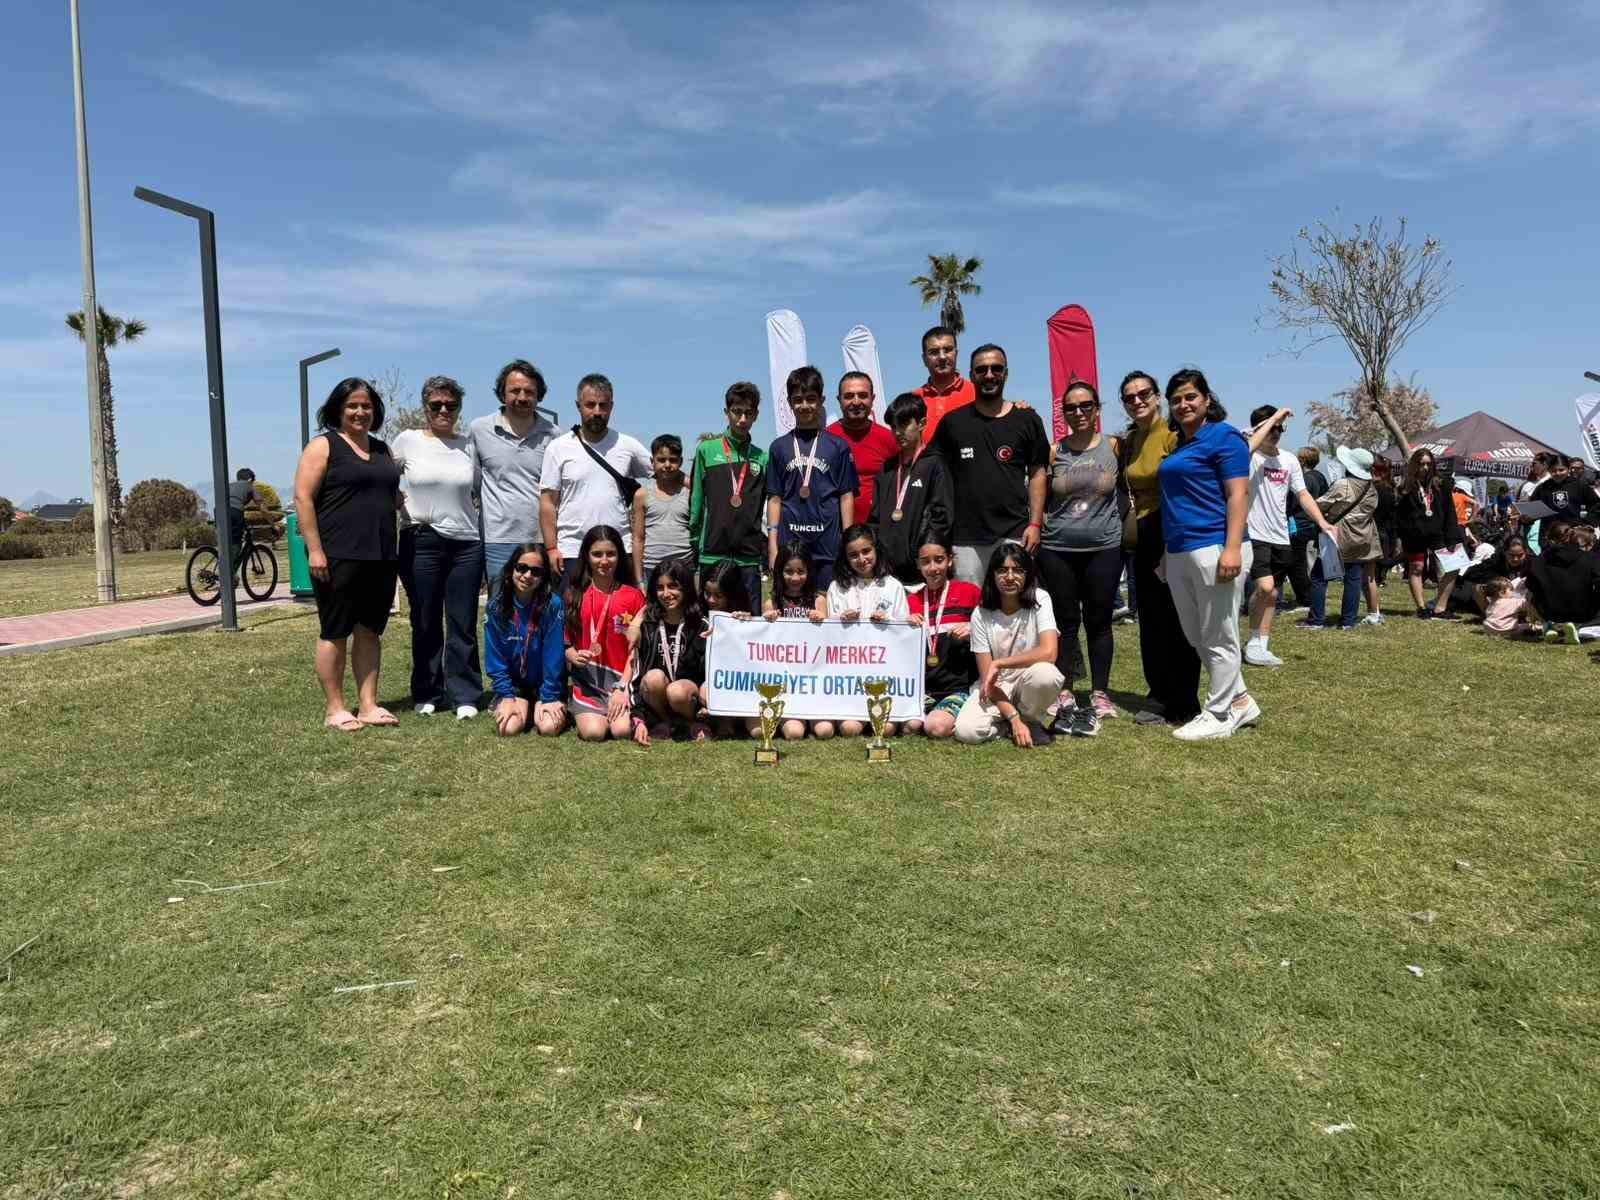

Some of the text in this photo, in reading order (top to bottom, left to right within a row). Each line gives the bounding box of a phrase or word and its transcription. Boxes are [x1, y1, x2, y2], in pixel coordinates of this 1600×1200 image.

[747, 641, 887, 665] TUNCELİ / MERKEZ
[823, 675, 916, 699] ORTAULU
